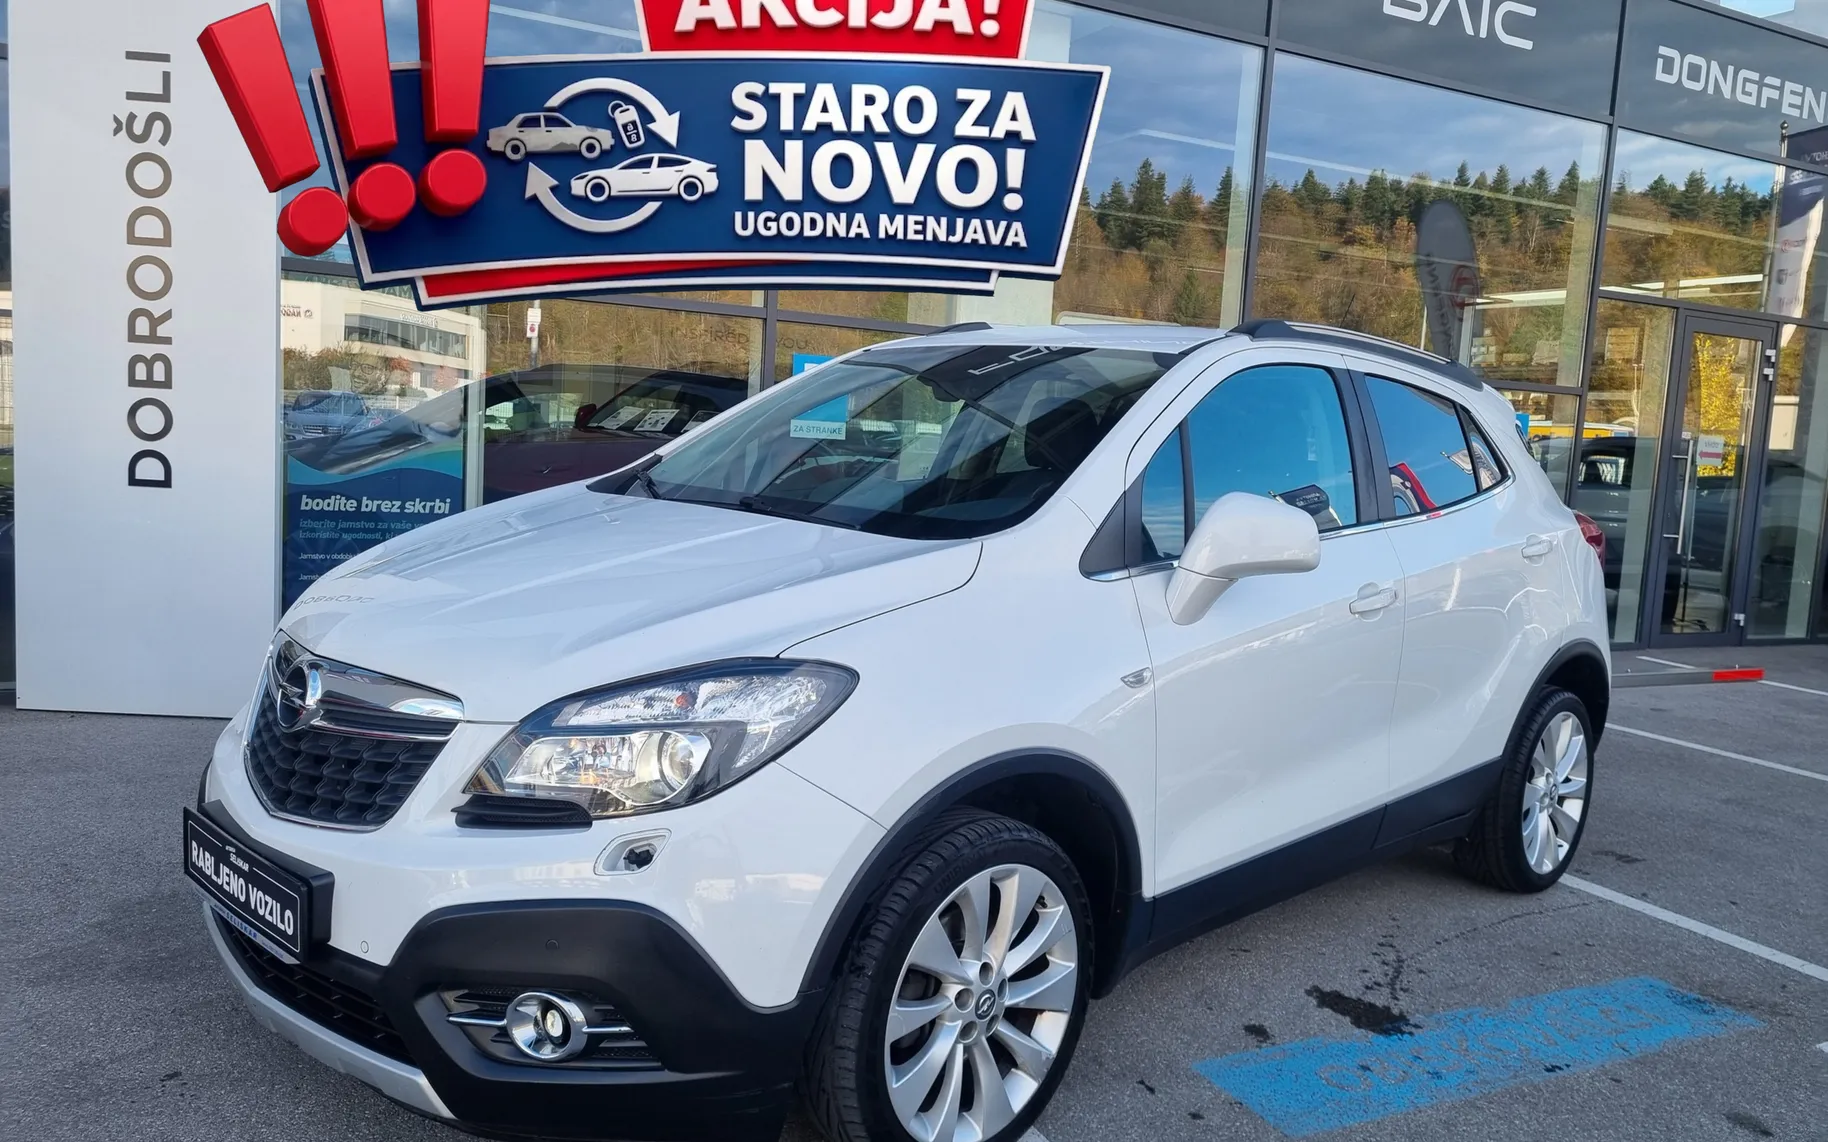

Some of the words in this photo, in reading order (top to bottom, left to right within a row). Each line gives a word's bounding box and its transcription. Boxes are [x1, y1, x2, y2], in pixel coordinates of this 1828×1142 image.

[113, 51, 173, 488] DOBRODOŠLI
[793, 424, 804, 433] ZA
[806, 425, 843, 435] STRANKE
[301, 495, 358, 512] bodite
[361, 496, 401, 513] brez
[404, 498, 451, 514] skrbi
[300, 519, 337, 529] izberite
[337, 519, 376, 530] jamstvo
[390, 520, 412, 530] vaše
[192, 840, 246, 903] RABLJENO
[248, 883, 294, 936] VOZILO
